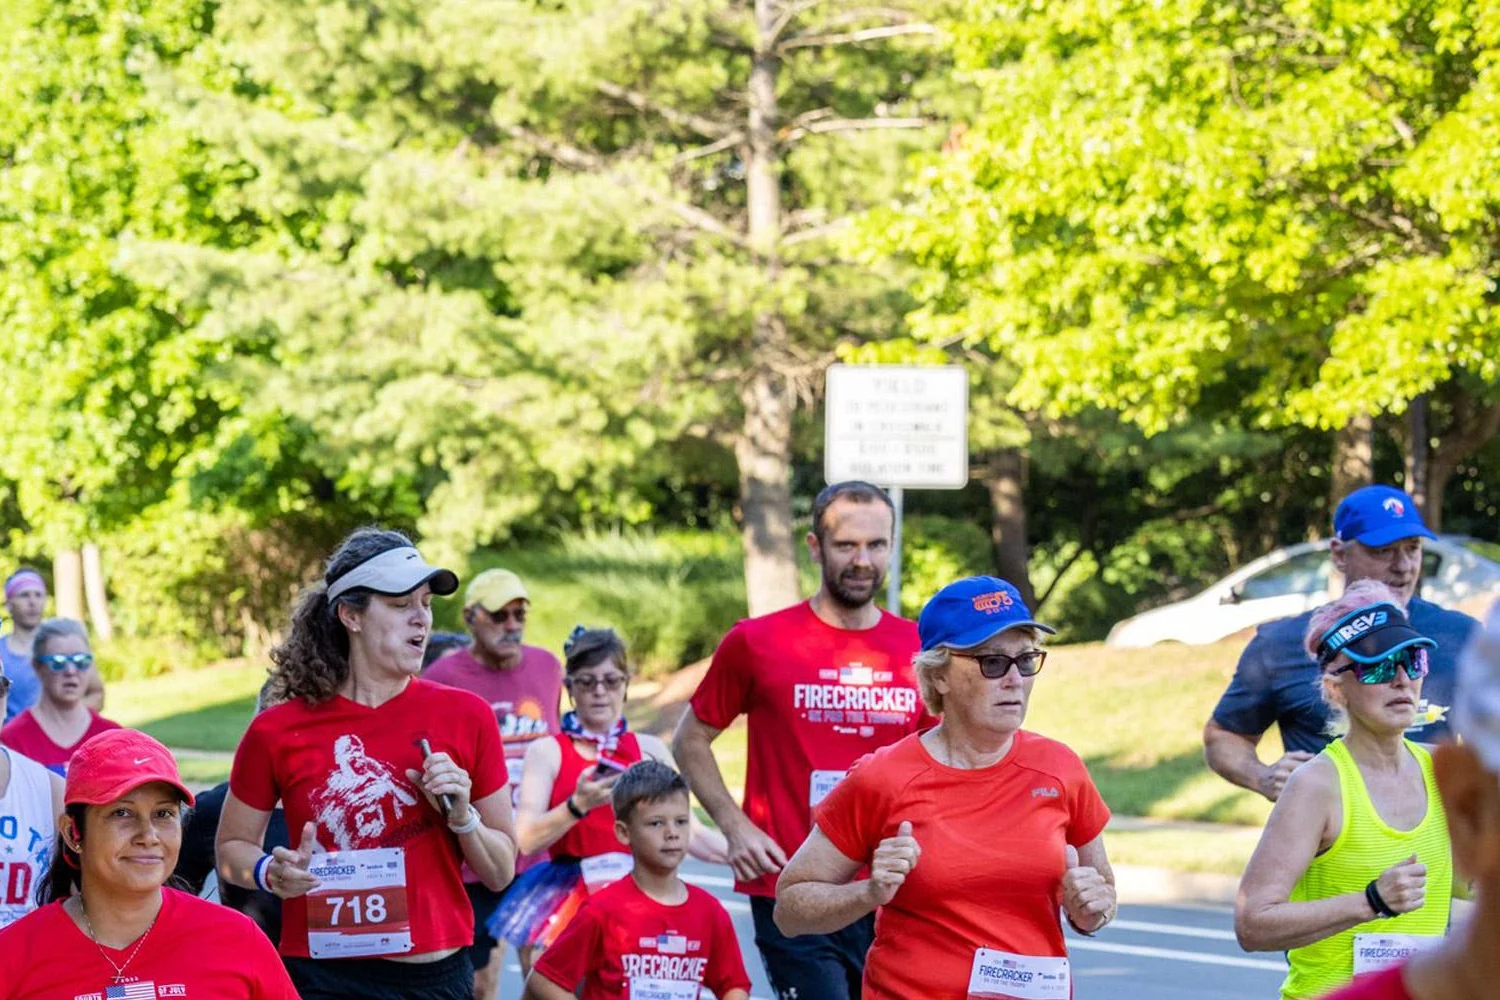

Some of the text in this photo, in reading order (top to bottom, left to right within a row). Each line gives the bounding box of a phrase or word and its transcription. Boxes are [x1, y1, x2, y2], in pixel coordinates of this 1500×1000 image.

[1338, 611, 1388, 640] REV3
[794, 684, 917, 712] FIRECRACKER
[326, 894, 387, 926] 718
[979, 965, 1033, 983] FIRECRACKER
[169, 986, 185, 994] JULY
